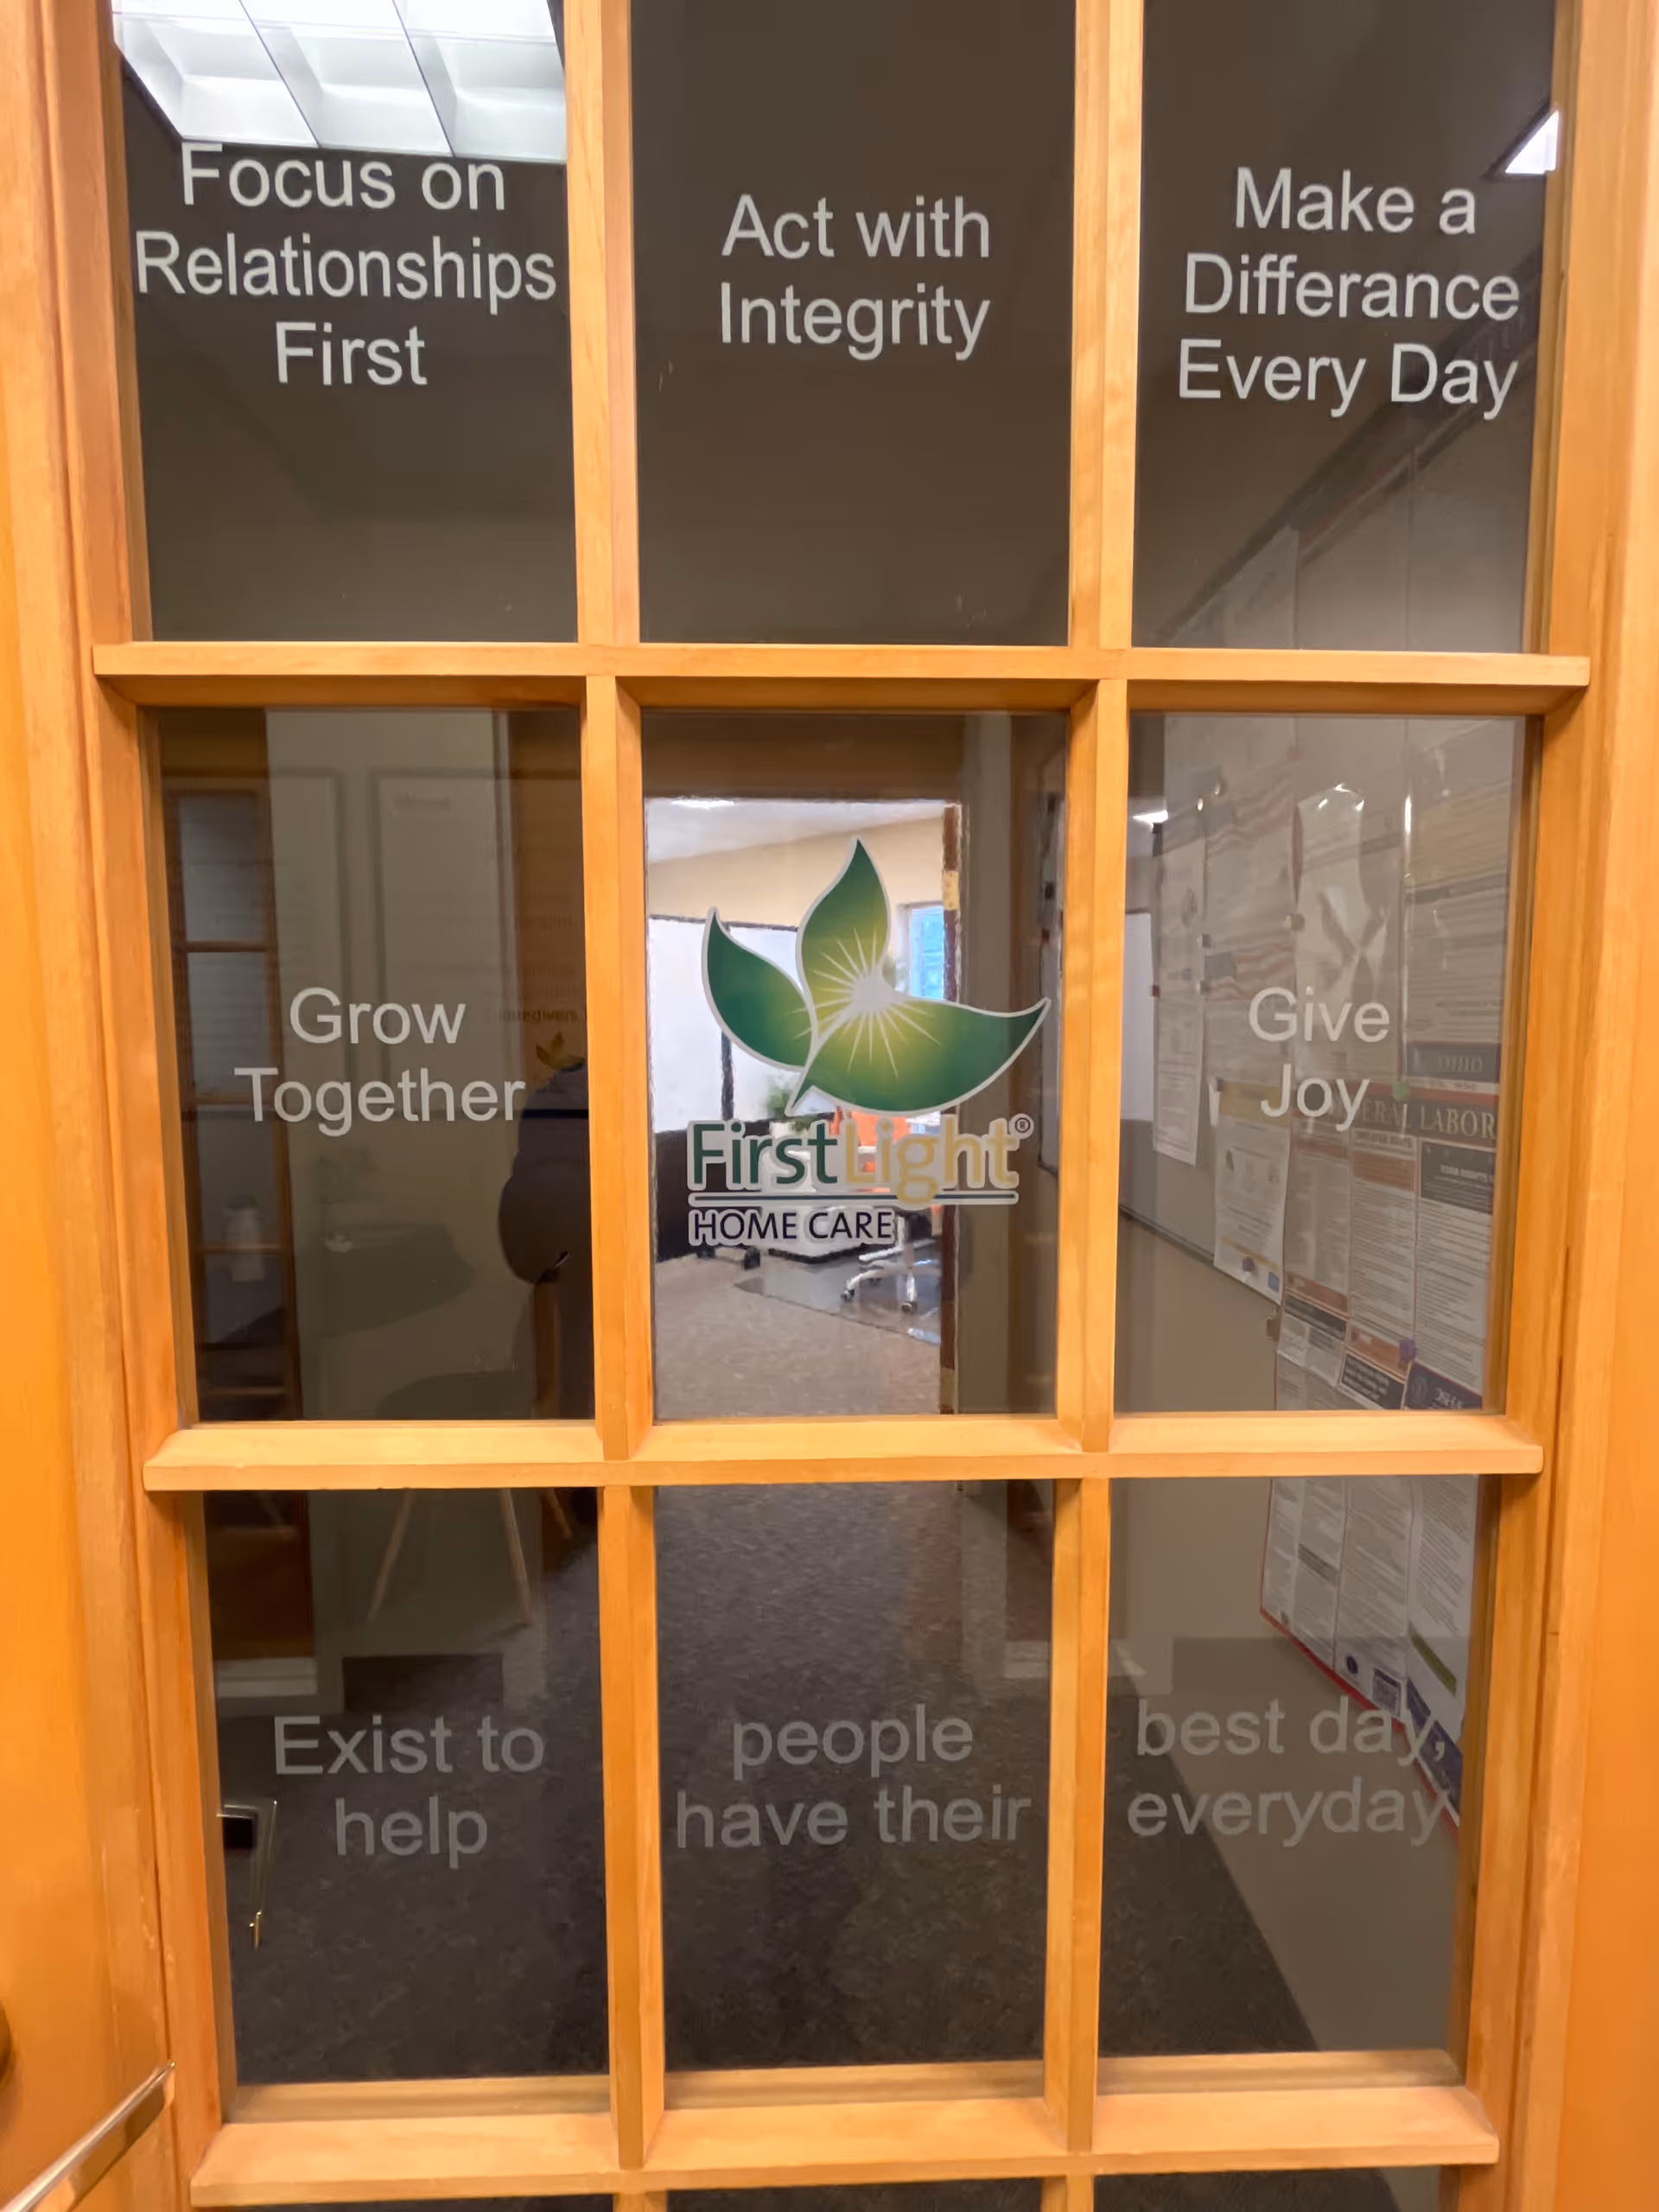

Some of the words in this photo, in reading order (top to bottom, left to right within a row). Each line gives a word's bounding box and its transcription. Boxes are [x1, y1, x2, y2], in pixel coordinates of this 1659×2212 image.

[181, 143, 396, 208] Focus
[422, 162, 505, 210] on
[1236, 167, 1414, 232] Make
[1440, 188, 1476, 234] a
[721, 194, 835, 258] Act
[855, 195, 988, 257] with
[136, 231, 556, 315] Relationships
[1185, 252, 1520, 321] Differance
[276, 321, 427, 385] First
[721, 283, 990, 360] Integrity
[1179, 339, 1366, 417] Every
[1391, 343, 1519, 421] Day
[290, 987, 466, 1044] Grow
[1249, 987, 1390, 1043] Give
[234, 1067, 525, 1137] Together
[1261, 1064, 1370, 1132] Joy
[1421, 1103, 1496, 1141] LABOR
[694, 1211, 797, 1240] HOME
[808, 1211, 893, 1240] CARE
[274, 1714, 453, 1774] Exist
[477, 1715, 544, 1772] to
[733, 1703, 973, 1781] people
[1136, 1699, 1285, 1756] best
[335, 1795, 487, 1869] help
[677, 1789, 849, 1848] have
[874, 1783, 1032, 1843] their
[1128, 1776, 1449, 1847] everyday
